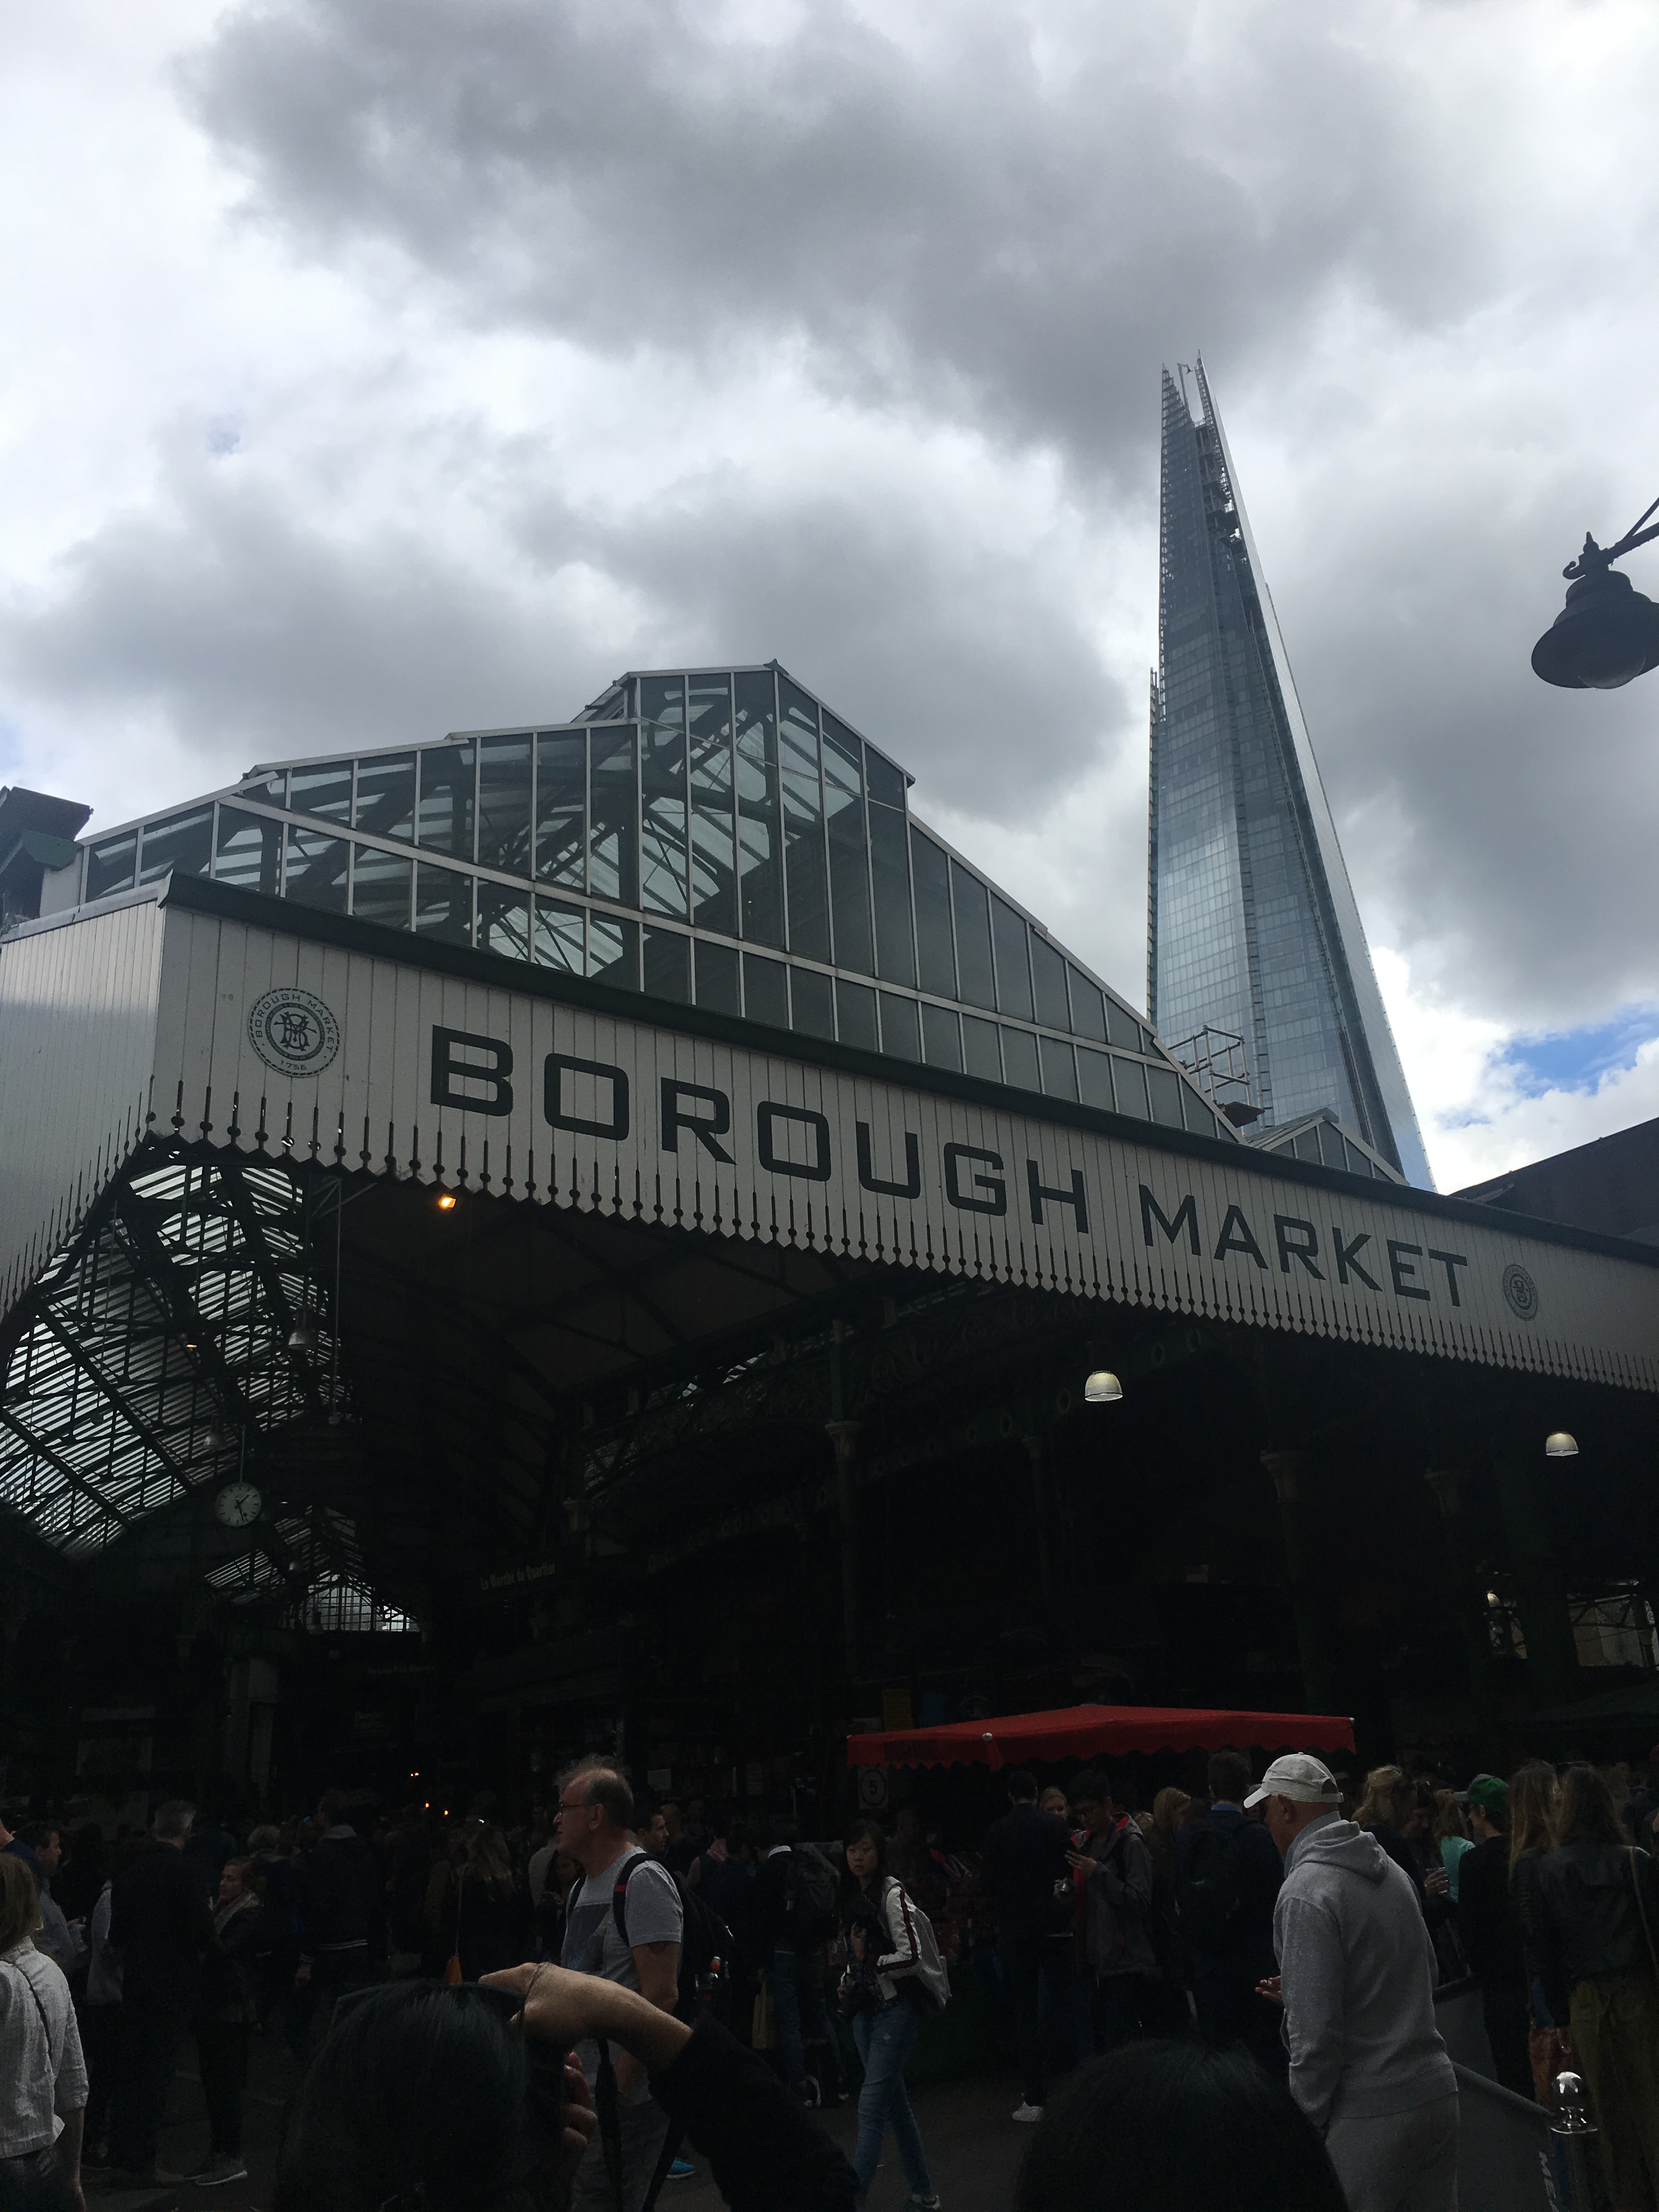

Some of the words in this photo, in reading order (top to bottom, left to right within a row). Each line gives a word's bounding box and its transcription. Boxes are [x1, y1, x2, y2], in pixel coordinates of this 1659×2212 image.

[255, 994, 301, 1037] BOROUGH
[307, 1000, 335, 1053] MARKET
[280, 1060, 307, 1070] 1756
[431, 1025, 1088, 1234] BOROUGH
[1139, 1184, 1468, 1307] MARKET
[869, 1780, 878, 1795] 5
